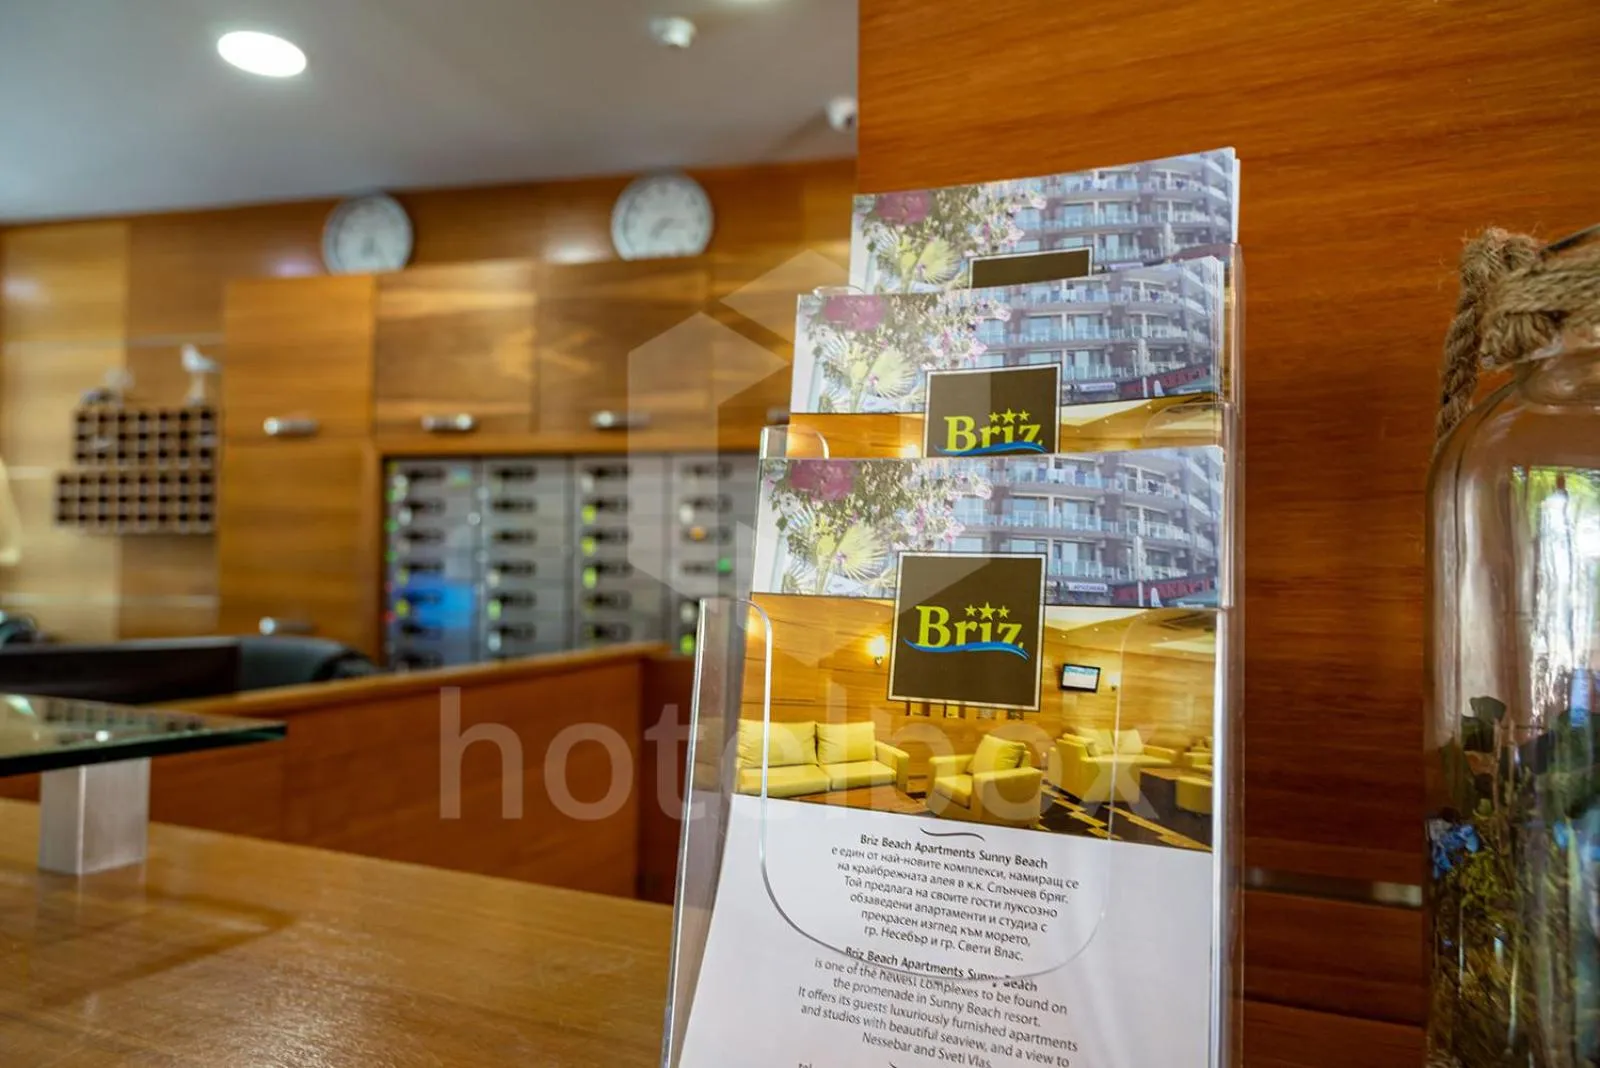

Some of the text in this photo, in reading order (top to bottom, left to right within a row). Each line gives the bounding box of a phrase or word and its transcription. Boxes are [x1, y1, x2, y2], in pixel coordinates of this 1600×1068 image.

[944, 415, 1043, 452] Briz
[915, 605, 1024, 648] Briz
[831, 847, 1079, 889] е един от най-новите комплекси, намиращ се
[860, 833, 1048, 869] Briz Beach Apartments Sunny Beach
[837, 862, 850, 871] на
[852, 864, 928, 883] крайбрежната
[930, 875, 955, 886] алея
[958, 880, 964, 888] в
[987, 881, 1037, 899] Слънчев
[1039, 889, 1069, 904] бряг.
[844, 875, 1058, 918] Той предлага на своите гости луксозно
[850, 893, 912, 910] обзаведени
[915, 903, 986, 922] апартаменти
[989, 916, 996, 924] и
[1040, 923, 1048, 933] с
[861, 910, 918, 926] прекрасен
[920, 920, 958, 935] изглед
[960, 927, 982, 938] към
[864, 925, 1024, 961] гр. Несебър и гр. Свети Влас.
[867, 950, 898, 966] Beach
[901, 957, 964, 978] Apartments
[815, 958, 1068, 1015] is one of the newest complexes to be found on
[833, 977, 1042, 1027] the promenade in Sunny Beach resort.
[798, 986, 1079, 1052] It offers its guests luxuriously furnished apartments
[801, 1004, 821, 1017] and
[822, 1008, 860, 1024] studios
[863, 1016, 887, 1030] with
[888, 1020, 939, 1040] beautiful
[990, 1042, 1013, 1057] and
[1015, 1049, 1022, 1059] a
[1025, 1050, 1054, 1065] view
[1056, 1055, 1070, 1068] to
[862, 1031, 912, 1052] Nessebar
[914, 1043, 936, 1058] and
[937, 1048, 965, 1062] Sveti
